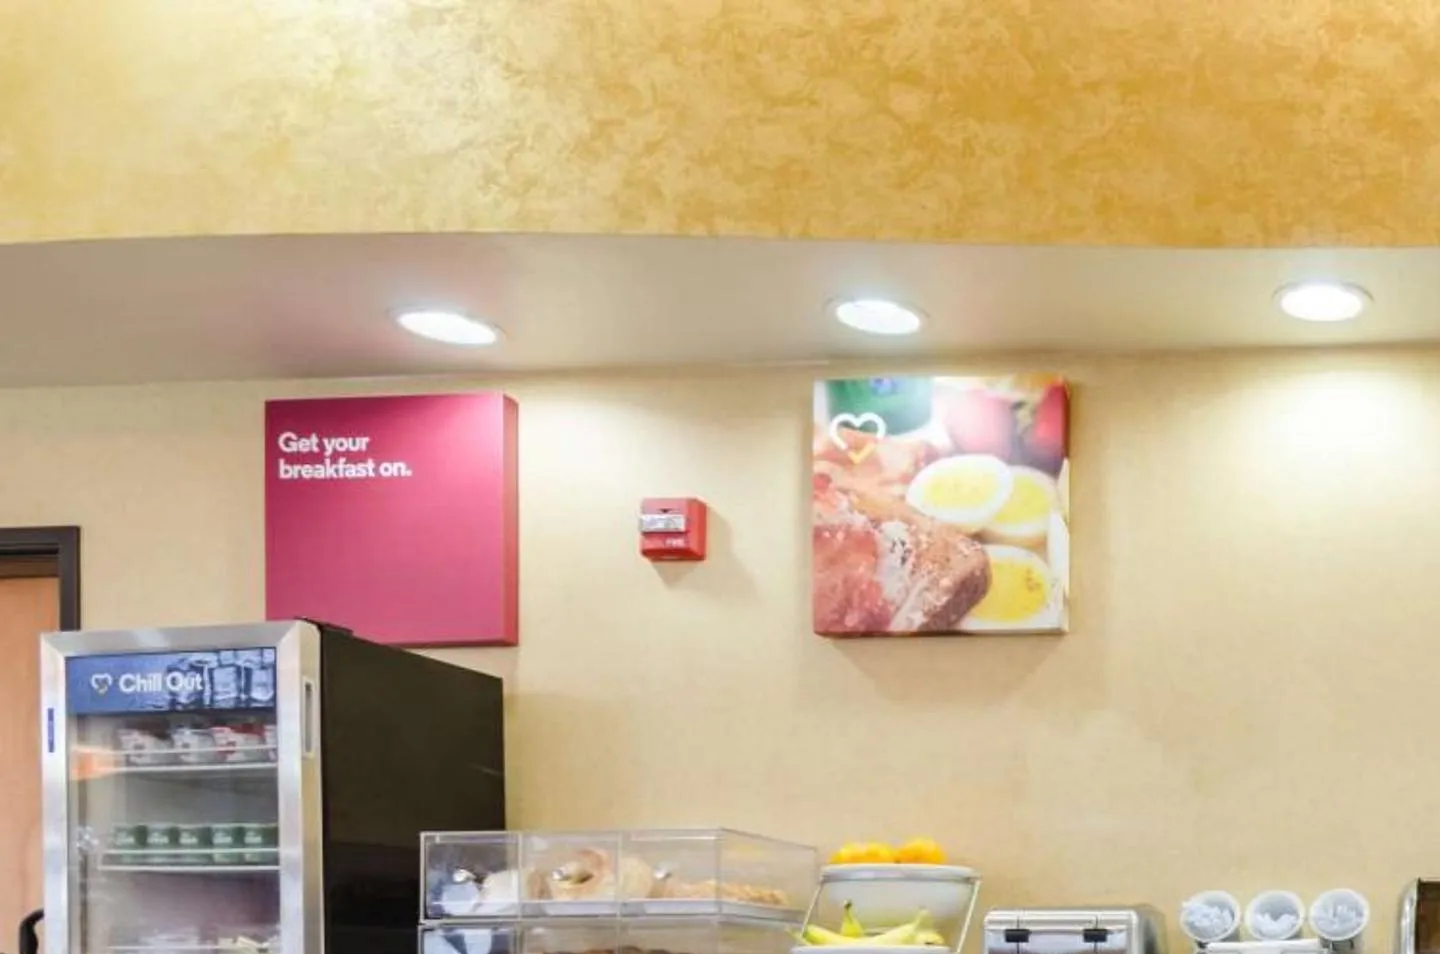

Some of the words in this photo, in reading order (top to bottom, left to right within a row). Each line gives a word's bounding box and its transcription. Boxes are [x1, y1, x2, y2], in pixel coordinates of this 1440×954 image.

[278, 431, 320, 453] Get
[323, 436, 370, 456] your
[279, 459, 376, 479] breakfast
[379, 462, 413, 478] on.
[118, 672, 163, 693] Chill
[166, 671, 204, 692] Out
